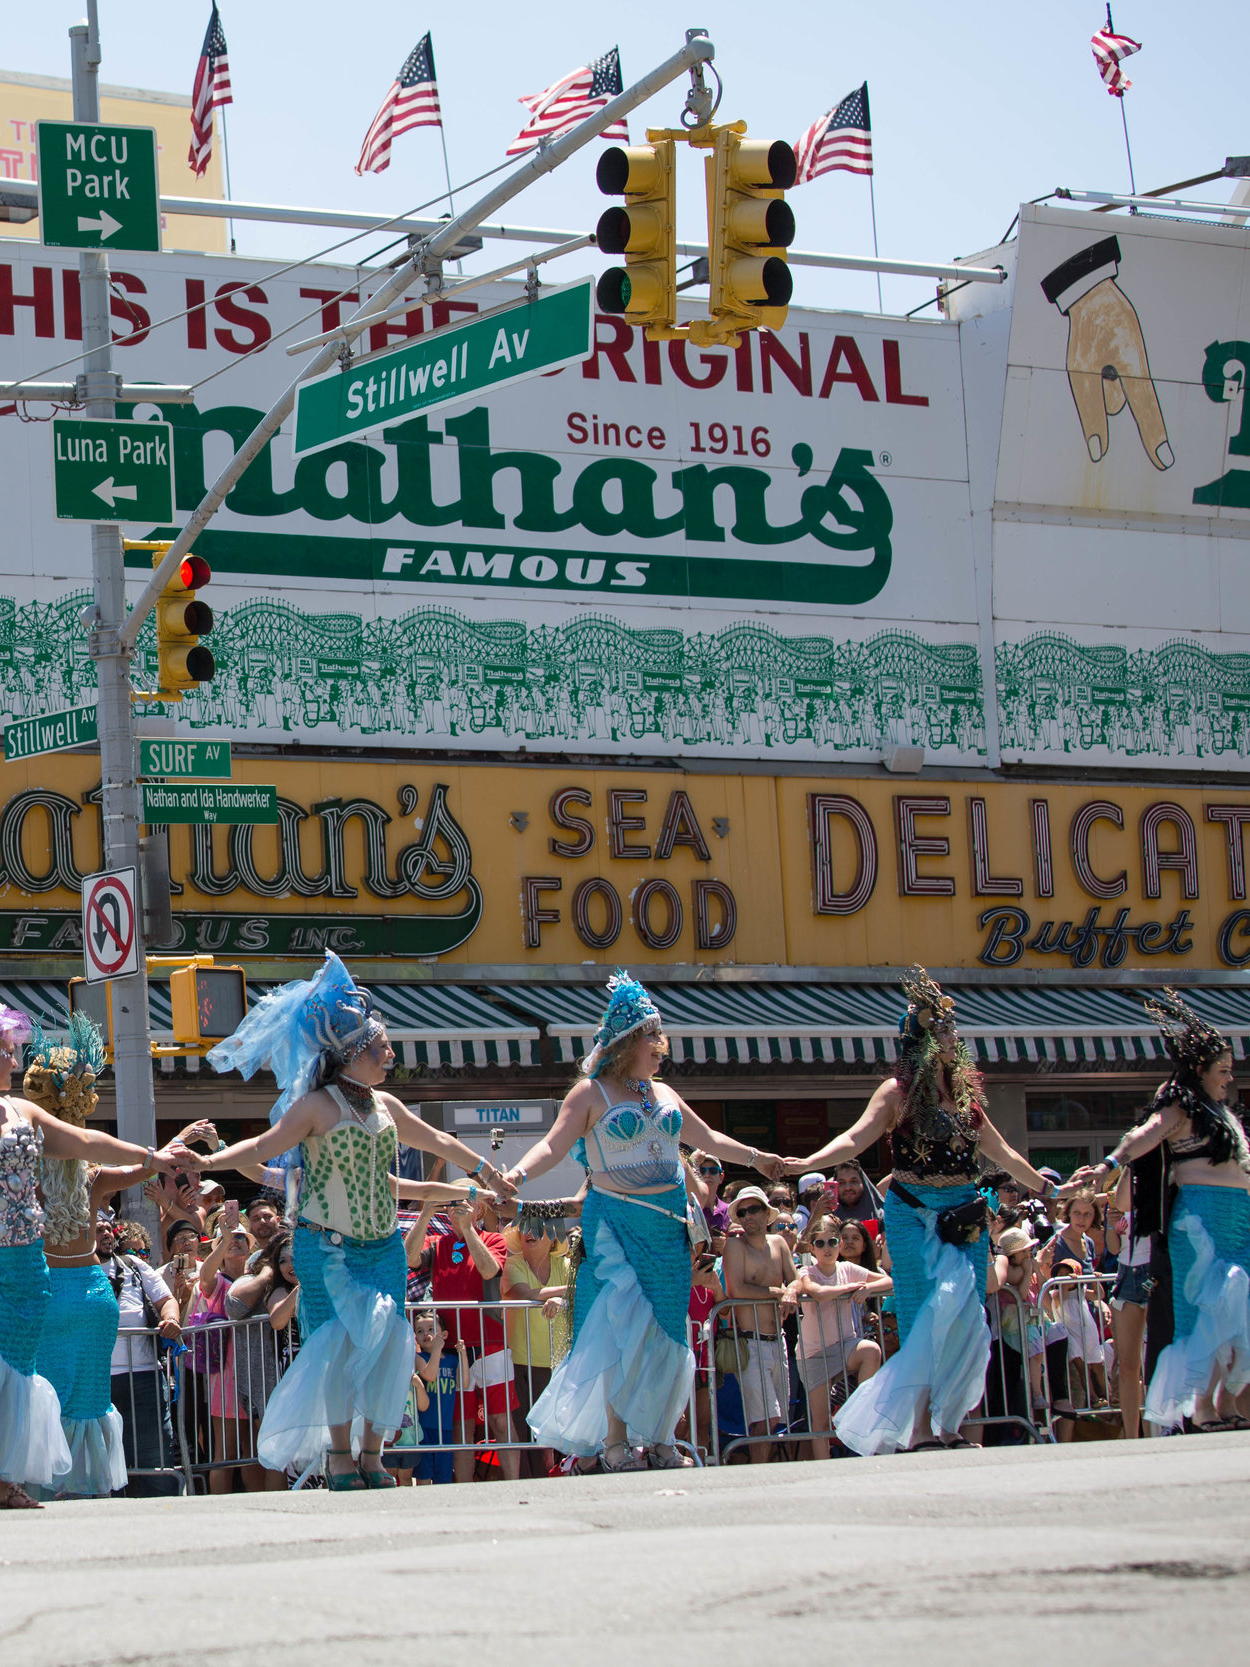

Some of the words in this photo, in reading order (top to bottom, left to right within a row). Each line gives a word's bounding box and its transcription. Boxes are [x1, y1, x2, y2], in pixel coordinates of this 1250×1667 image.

[66, 133, 128, 164] MCU
[66, 168, 130, 199] Park
[185, 278, 272, 355] IS
[539, 314, 930, 407] RIGINAL
[346, 341, 468, 419] Stillwell
[488, 328, 530, 369] Av
[56, 432, 108, 463] Luna
[119, 435, 167, 465] Park
[566, 411, 667, 451] Since
[689, 421, 772, 458] 1916
[382, 546, 650, 588] FAMOUS
[7, 711, 79, 758] Stillwell
[80, 708, 96, 725] Av
[149, 744, 198, 773] SURF
[205, 746, 220, 760] AV
[146, 787, 180, 809] Nathan
[181, 788, 198, 808] and
[200, 788, 215, 808] Ida
[216, 788, 270, 809] Handwerker
[203, 809, 218, 823] Way
[548, 785, 712, 861] SEA
[808, 791, 1250, 917] DELICAT
[521, 876, 738, 950] FOOD
[976, 904, 1195, 969] Buffet
[476, 1107, 520, 1123] TITAN
[426, 1377, 456, 1395] MVP
